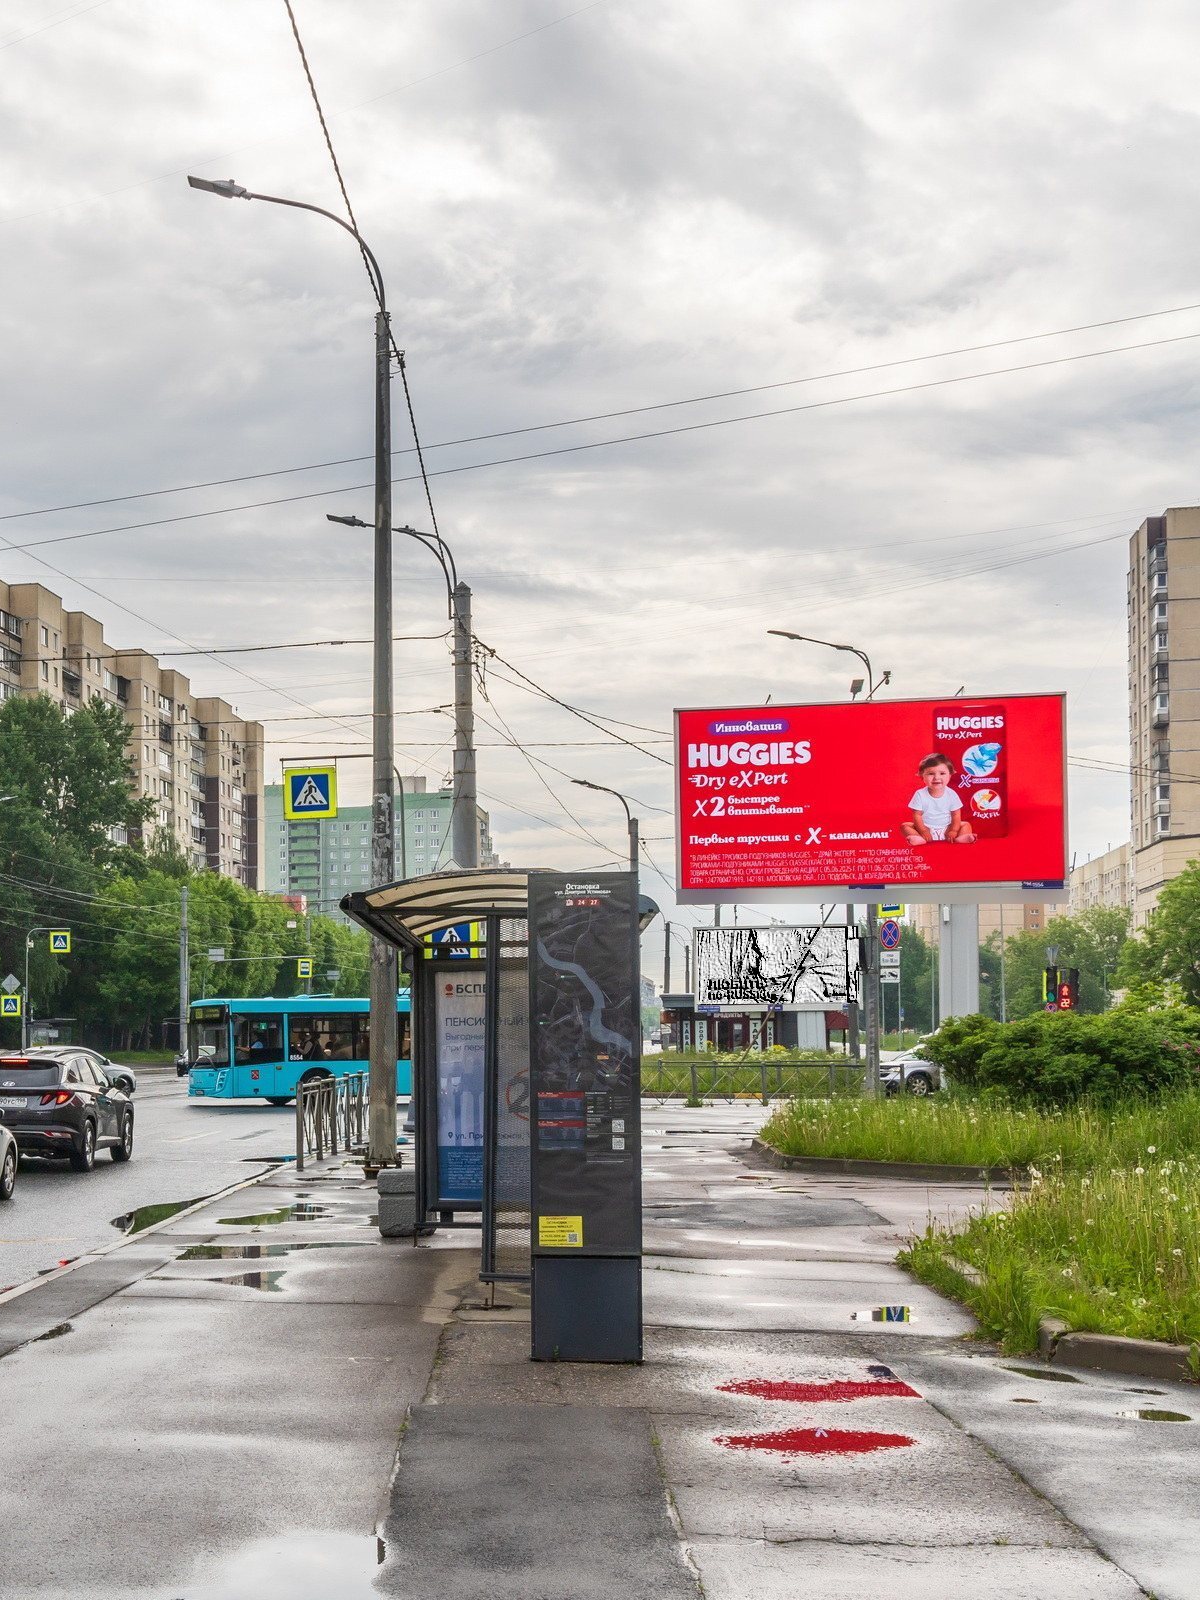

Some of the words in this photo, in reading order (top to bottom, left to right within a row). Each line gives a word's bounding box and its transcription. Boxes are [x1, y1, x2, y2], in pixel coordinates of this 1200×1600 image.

[714, 720, 783, 733] Инновация
[936, 715, 1004, 731] HUGGIES
[938, 731, 953, 740] Dry
[687, 741, 812, 768] HUGGIES
[692, 774, 726, 790] Dry
[728, 795, 780, 806] быстрее
[689, 834, 734, 846] Первые
[736, 833, 789, 846] трусики
